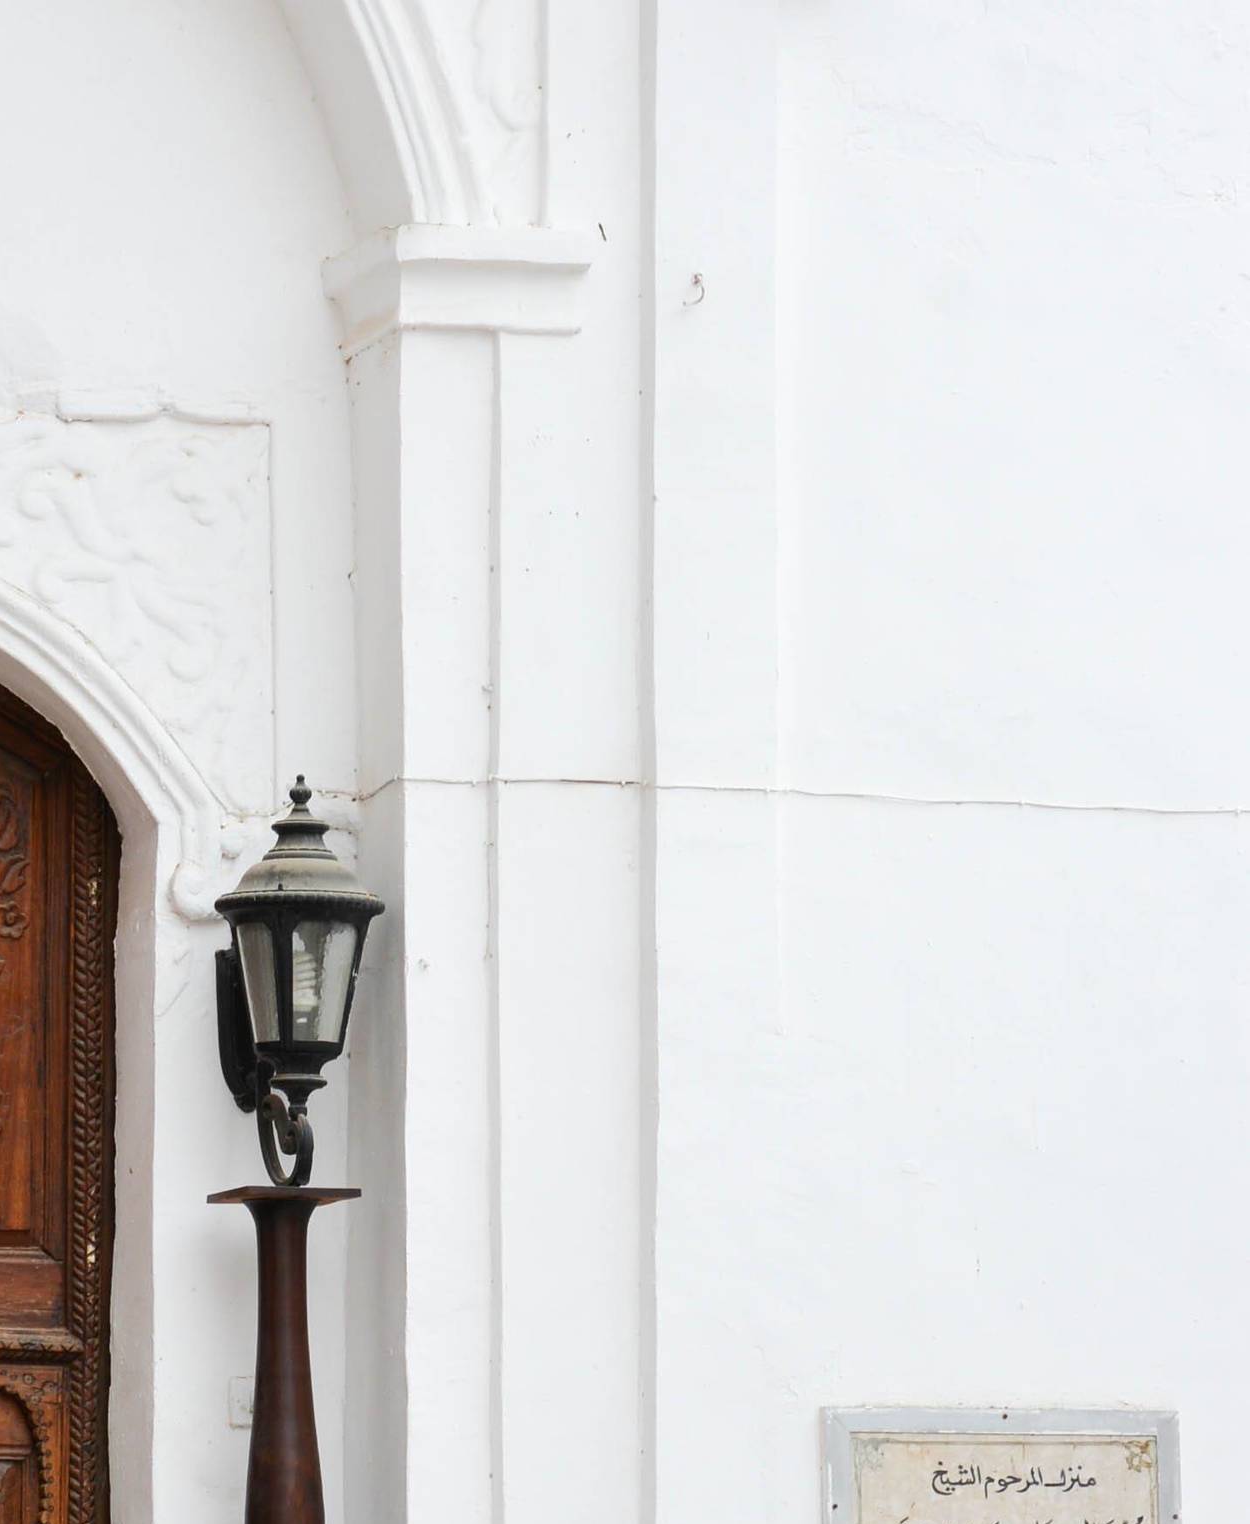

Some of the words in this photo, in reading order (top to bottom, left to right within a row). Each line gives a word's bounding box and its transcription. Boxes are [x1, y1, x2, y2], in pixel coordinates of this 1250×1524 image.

[931, 1460, 982, 1496] الشيخ
[984, 1466, 1044, 1499] المرحوم
[1043, 1465, 1097, 1493] منزل
